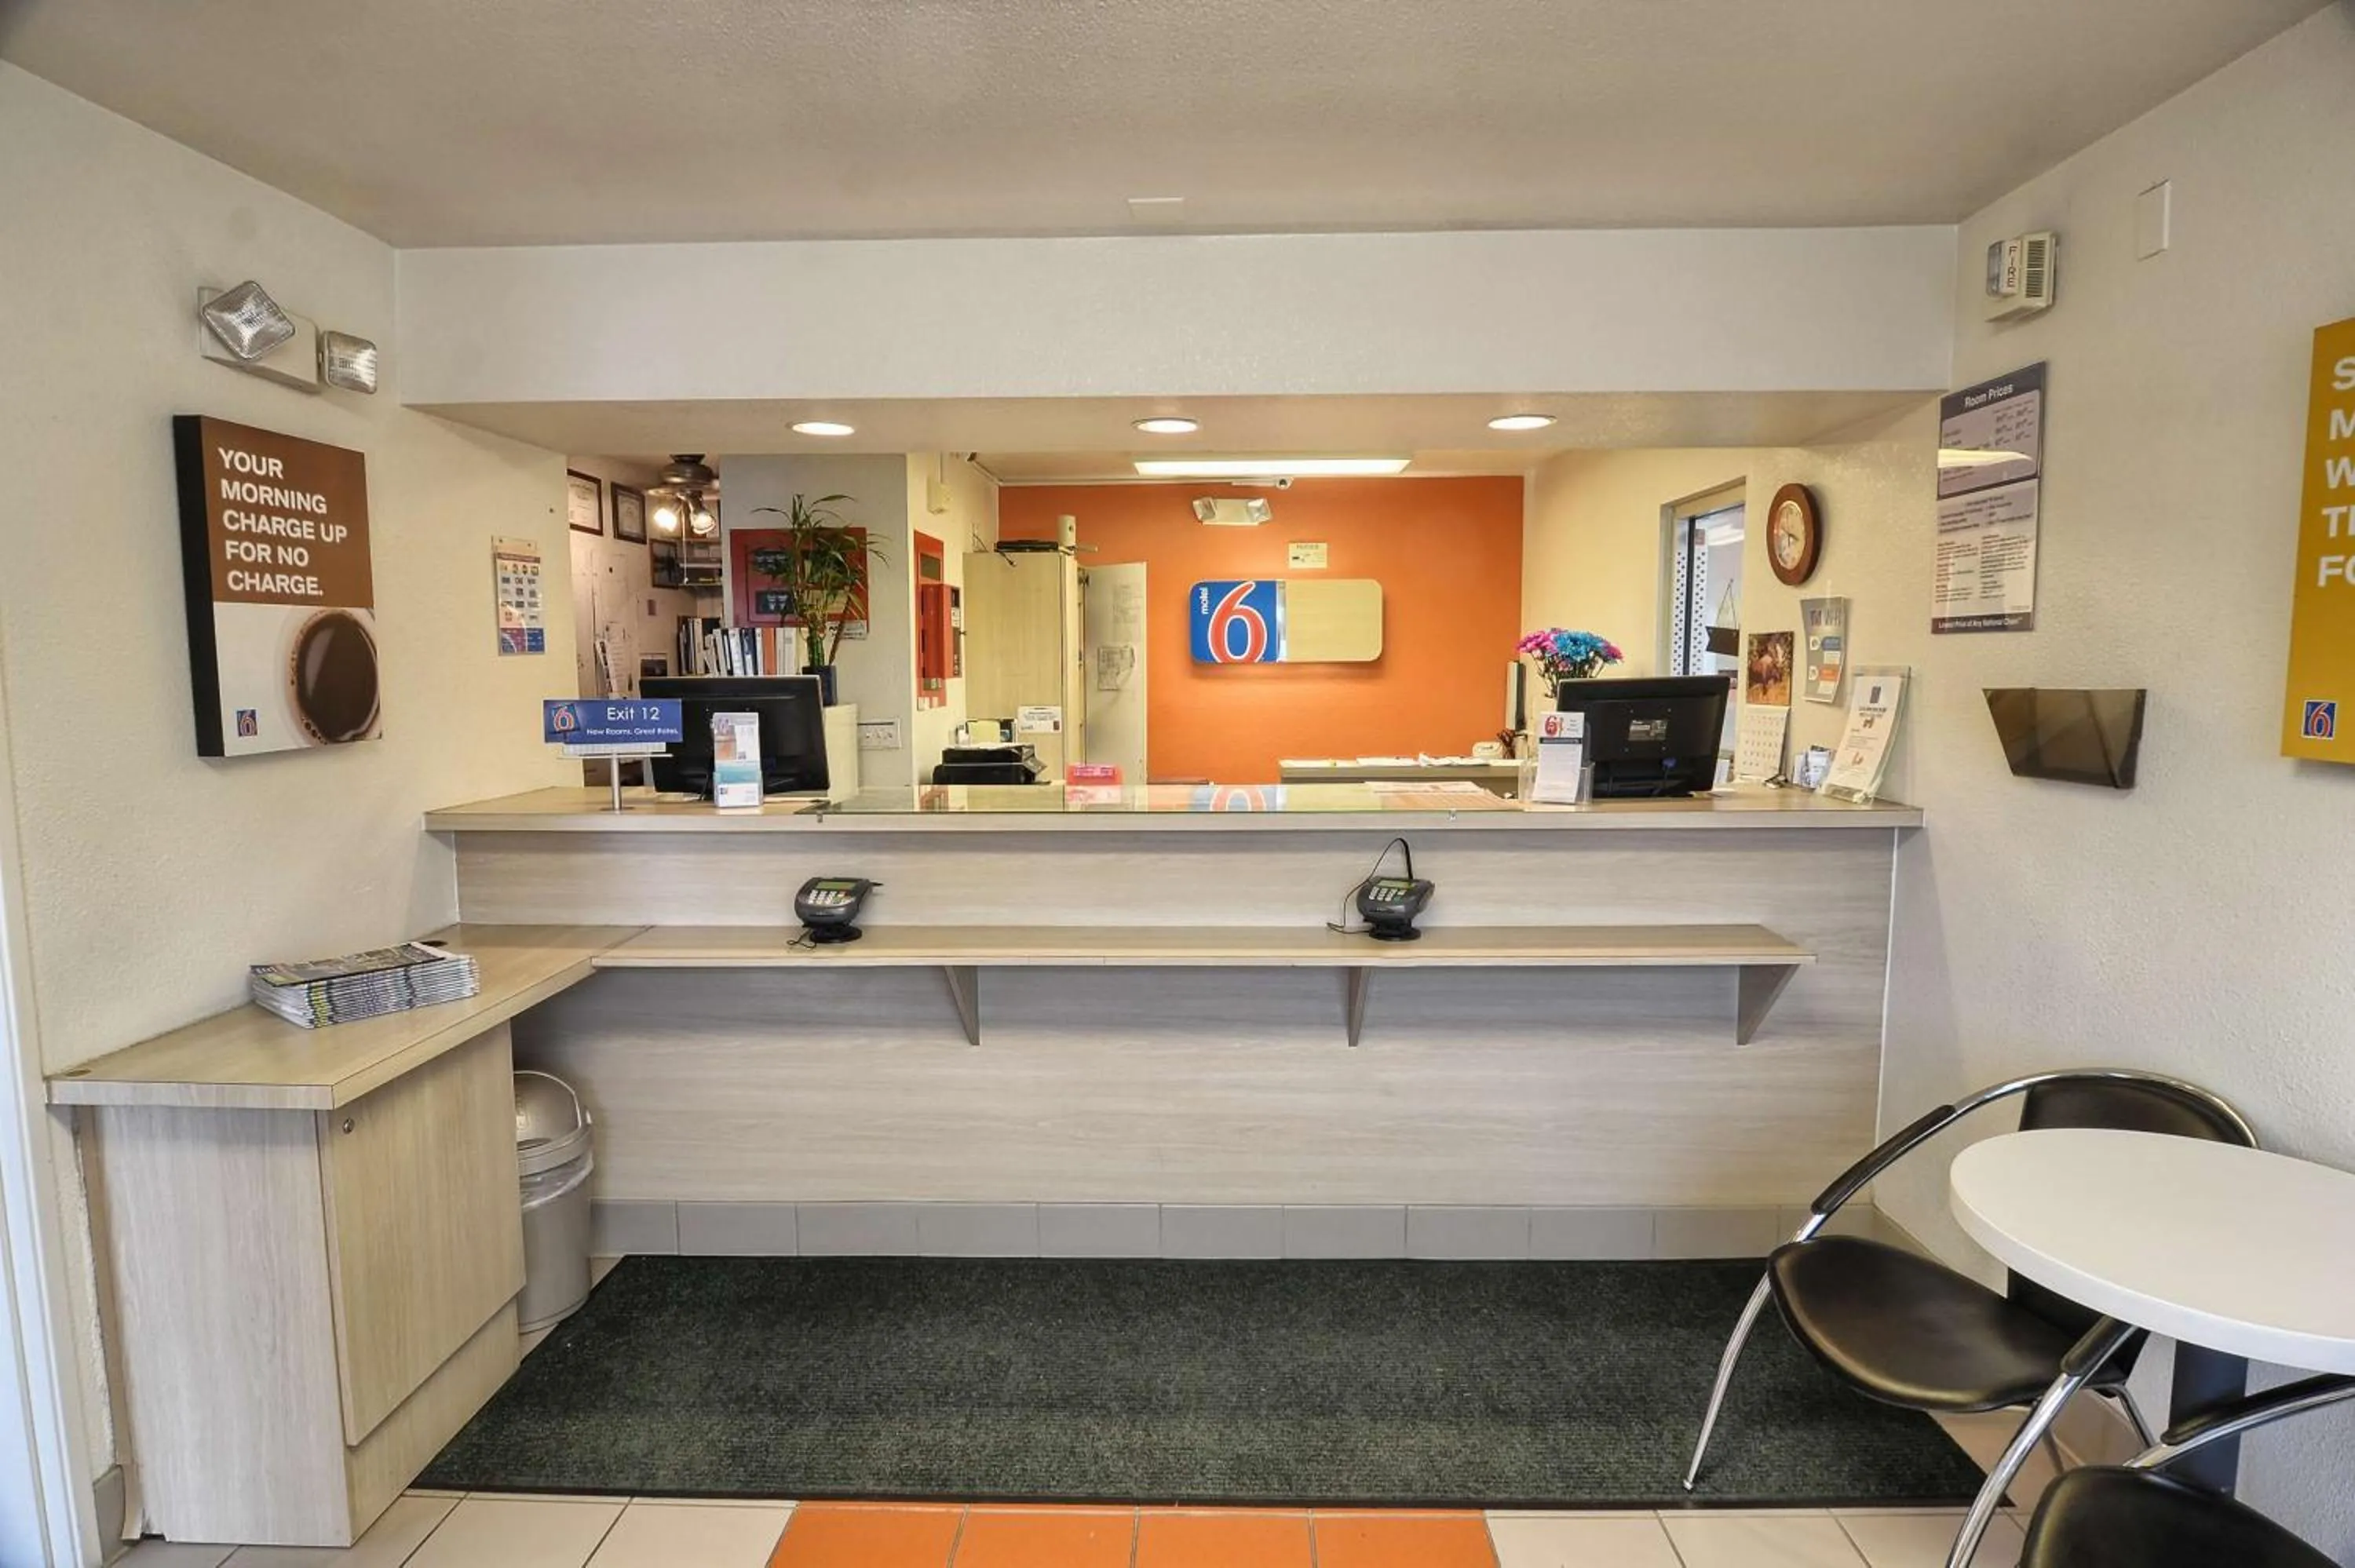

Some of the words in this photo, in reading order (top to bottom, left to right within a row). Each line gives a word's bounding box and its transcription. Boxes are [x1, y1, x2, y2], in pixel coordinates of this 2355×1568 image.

[2007, 246, 2017, 288] FIRE
[1965, 393, 1987, 408] Room
[1989, 384, 2014, 400] Prices
[217, 447, 283, 480] YOUR
[221, 478, 327, 515] MORNING
[222, 509, 316, 540] CHARGE
[319, 523, 348, 543] UP
[225, 539, 272, 563] FOR
[276, 545, 309, 567] NO
[227, 570, 323, 596] CHARGE.
[1199, 586, 1209, 615] motel
[1207, 581, 1268, 663] 6
[607, 707, 633, 721] Exit
[641, 707, 660, 720] 12
